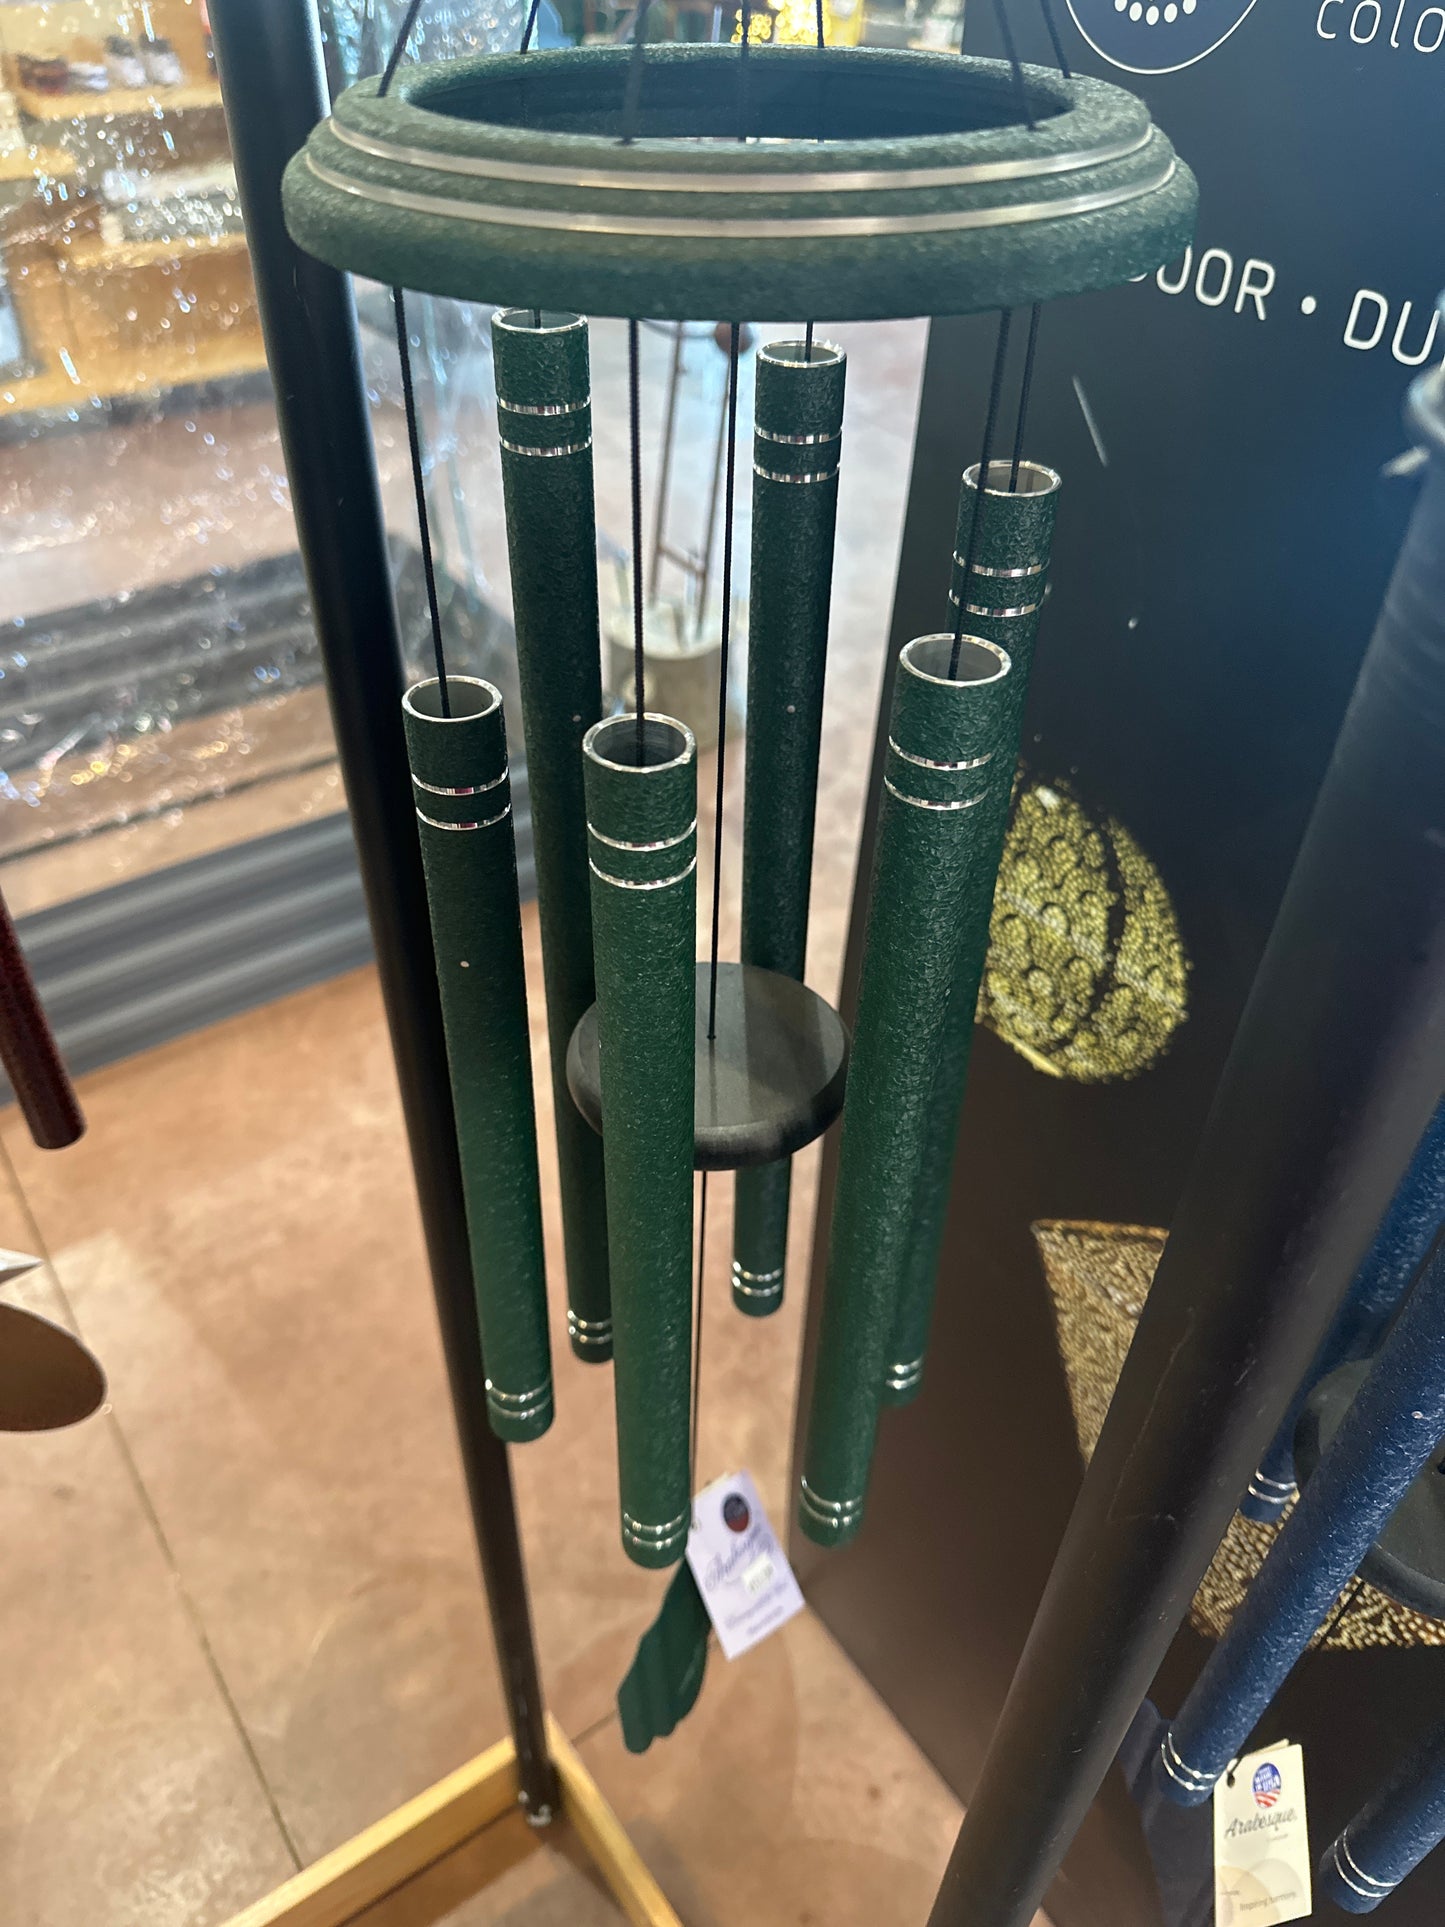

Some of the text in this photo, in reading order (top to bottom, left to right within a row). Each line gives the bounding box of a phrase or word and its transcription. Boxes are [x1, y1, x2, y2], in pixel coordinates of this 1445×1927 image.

[1316, 0, 1445, 53] colo
[1128, 245, 1445, 370] OOR DU
[1224, 1808, 1296, 1838] Arabesque
